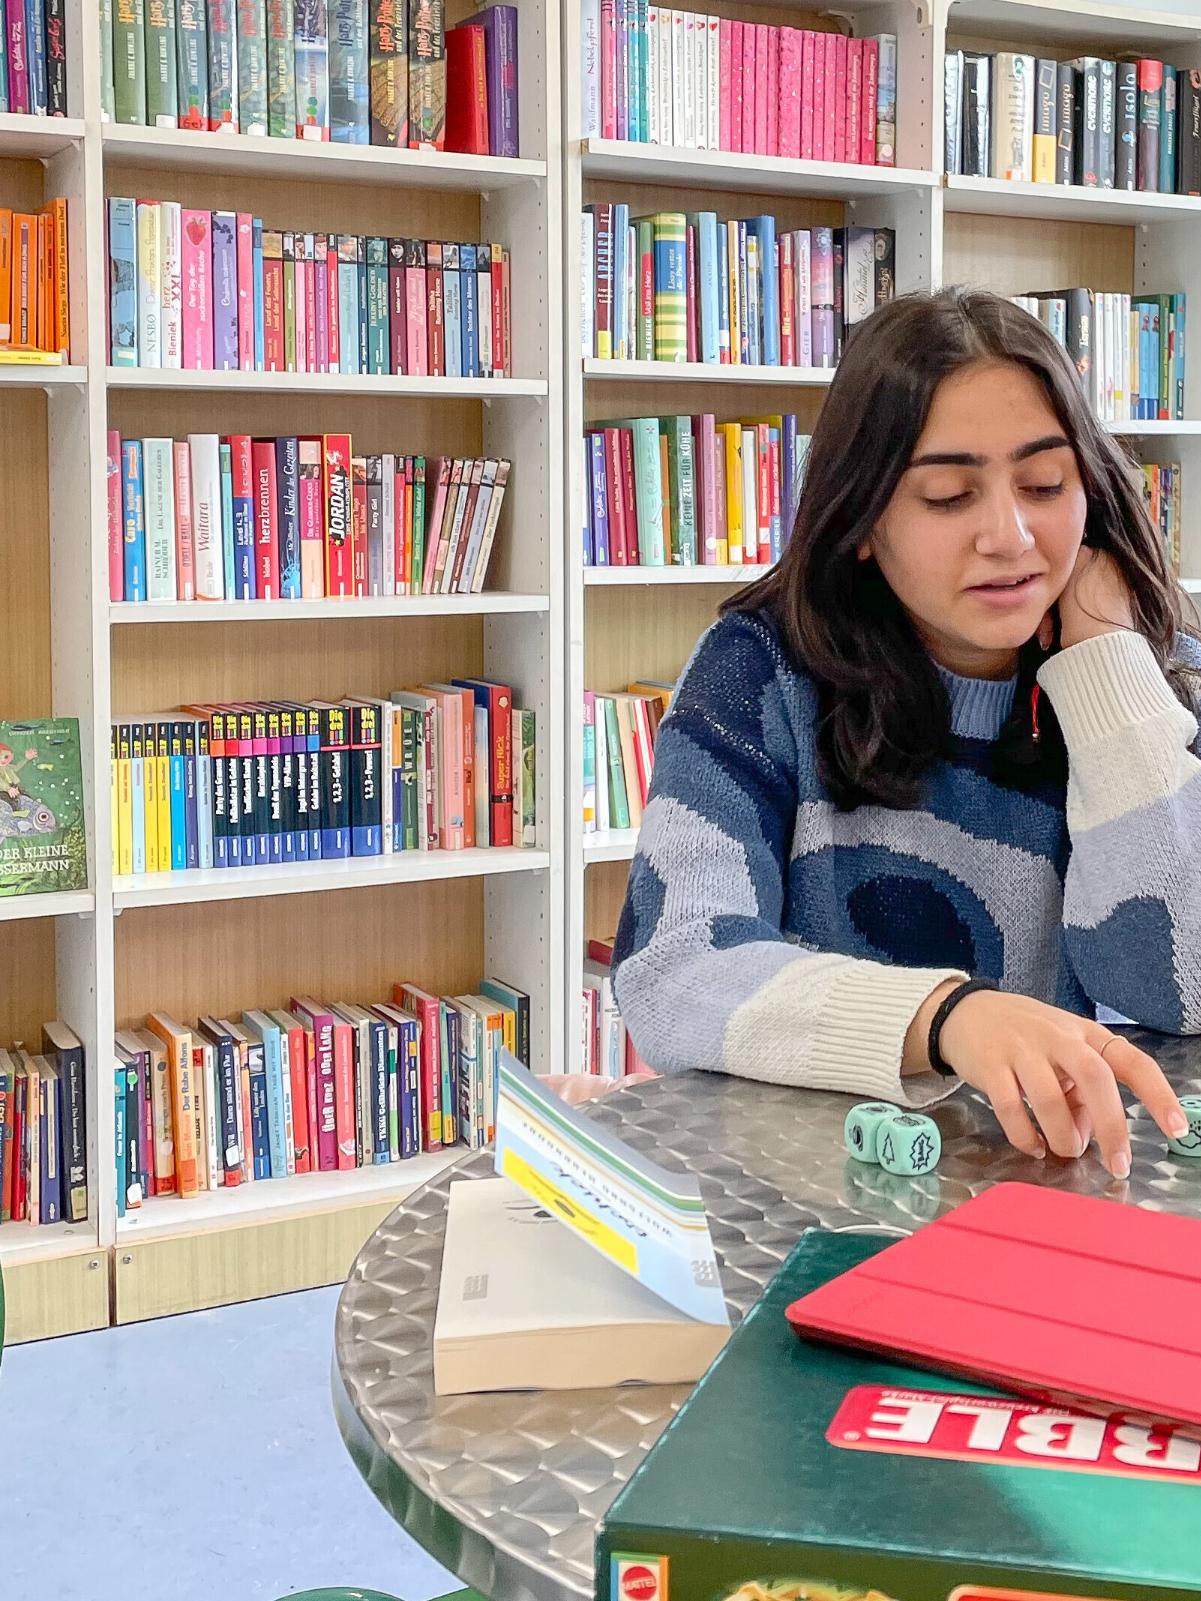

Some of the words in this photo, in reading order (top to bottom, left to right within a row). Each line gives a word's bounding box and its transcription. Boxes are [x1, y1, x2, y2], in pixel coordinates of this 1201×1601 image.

[338, 20, 354, 47] Harry
[378, 25, 394, 52] Harry
[417, 30, 432, 57] Harry
[586, 18, 597, 75] Nebelpferd
[1087, 75, 1097, 131] evermore
[1102, 79, 1112, 134] evermore
[198, 250, 206, 273] Rache
[597, 231, 614, 281] ARCHER
[188, 263, 196, 277] der
[161, 286, 171, 309] herz
[171, 272, 181, 301] XXL
[189, 278, 198, 292] Tag
[167, 321, 177, 356] Bieniek
[283, 441, 296, 475] Gezeiten
[682, 459, 692, 476] FÜR
[284, 488, 296, 516] Kinder
[682, 479, 692, 498] ZEIT
[258, 469, 271, 544] herzbrennen
[328, 474, 345, 539] JORDAN
[372, 511, 380, 528] Party
[682, 499, 693, 526] KEINE
[198, 502, 210, 552] Waitara
[497, 760, 508, 790] Super
[24, 844, 69, 859] KLEINE
[319, 1025, 333, 1052] LANG
[377, 1031, 385, 1072] Diamanten
[180, 1042, 188, 1069] Alfons
[223, 1054, 231, 1067] Flur
[320, 1051, 333, 1075] ODER
[181, 1071, 189, 1094] Rabe
[323, 1082, 334, 1104] KURZ
[321, 1106, 336, 1132] ÜBER
[379, 1116, 387, 1141] TKKG
[622, 1578, 657, 1590] MATTEL
